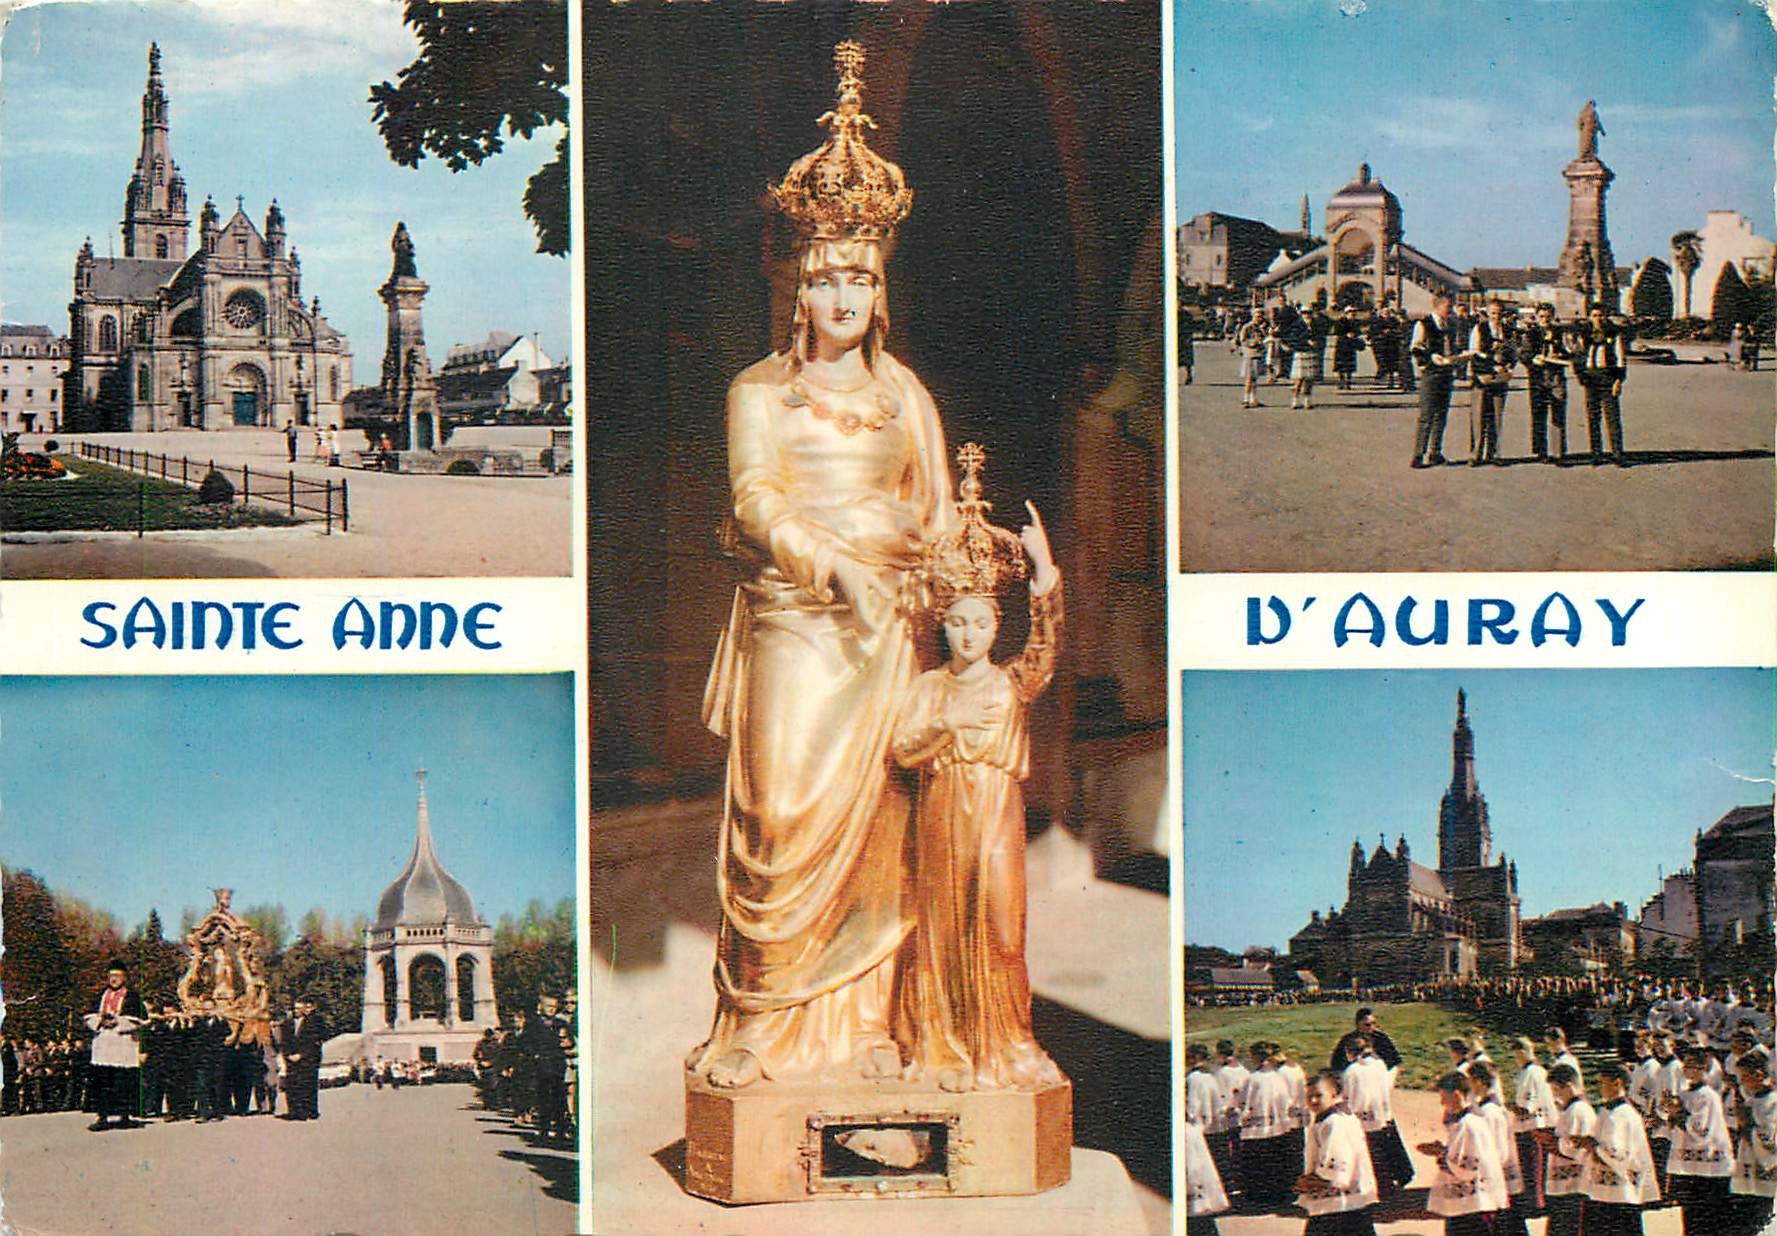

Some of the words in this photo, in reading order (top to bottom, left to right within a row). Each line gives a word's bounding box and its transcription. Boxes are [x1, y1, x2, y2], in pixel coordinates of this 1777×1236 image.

[80, 597, 303, 650] SAINTE
[332, 597, 502, 650] ANNE
[1247, 592, 1645, 648] D'AURAY
